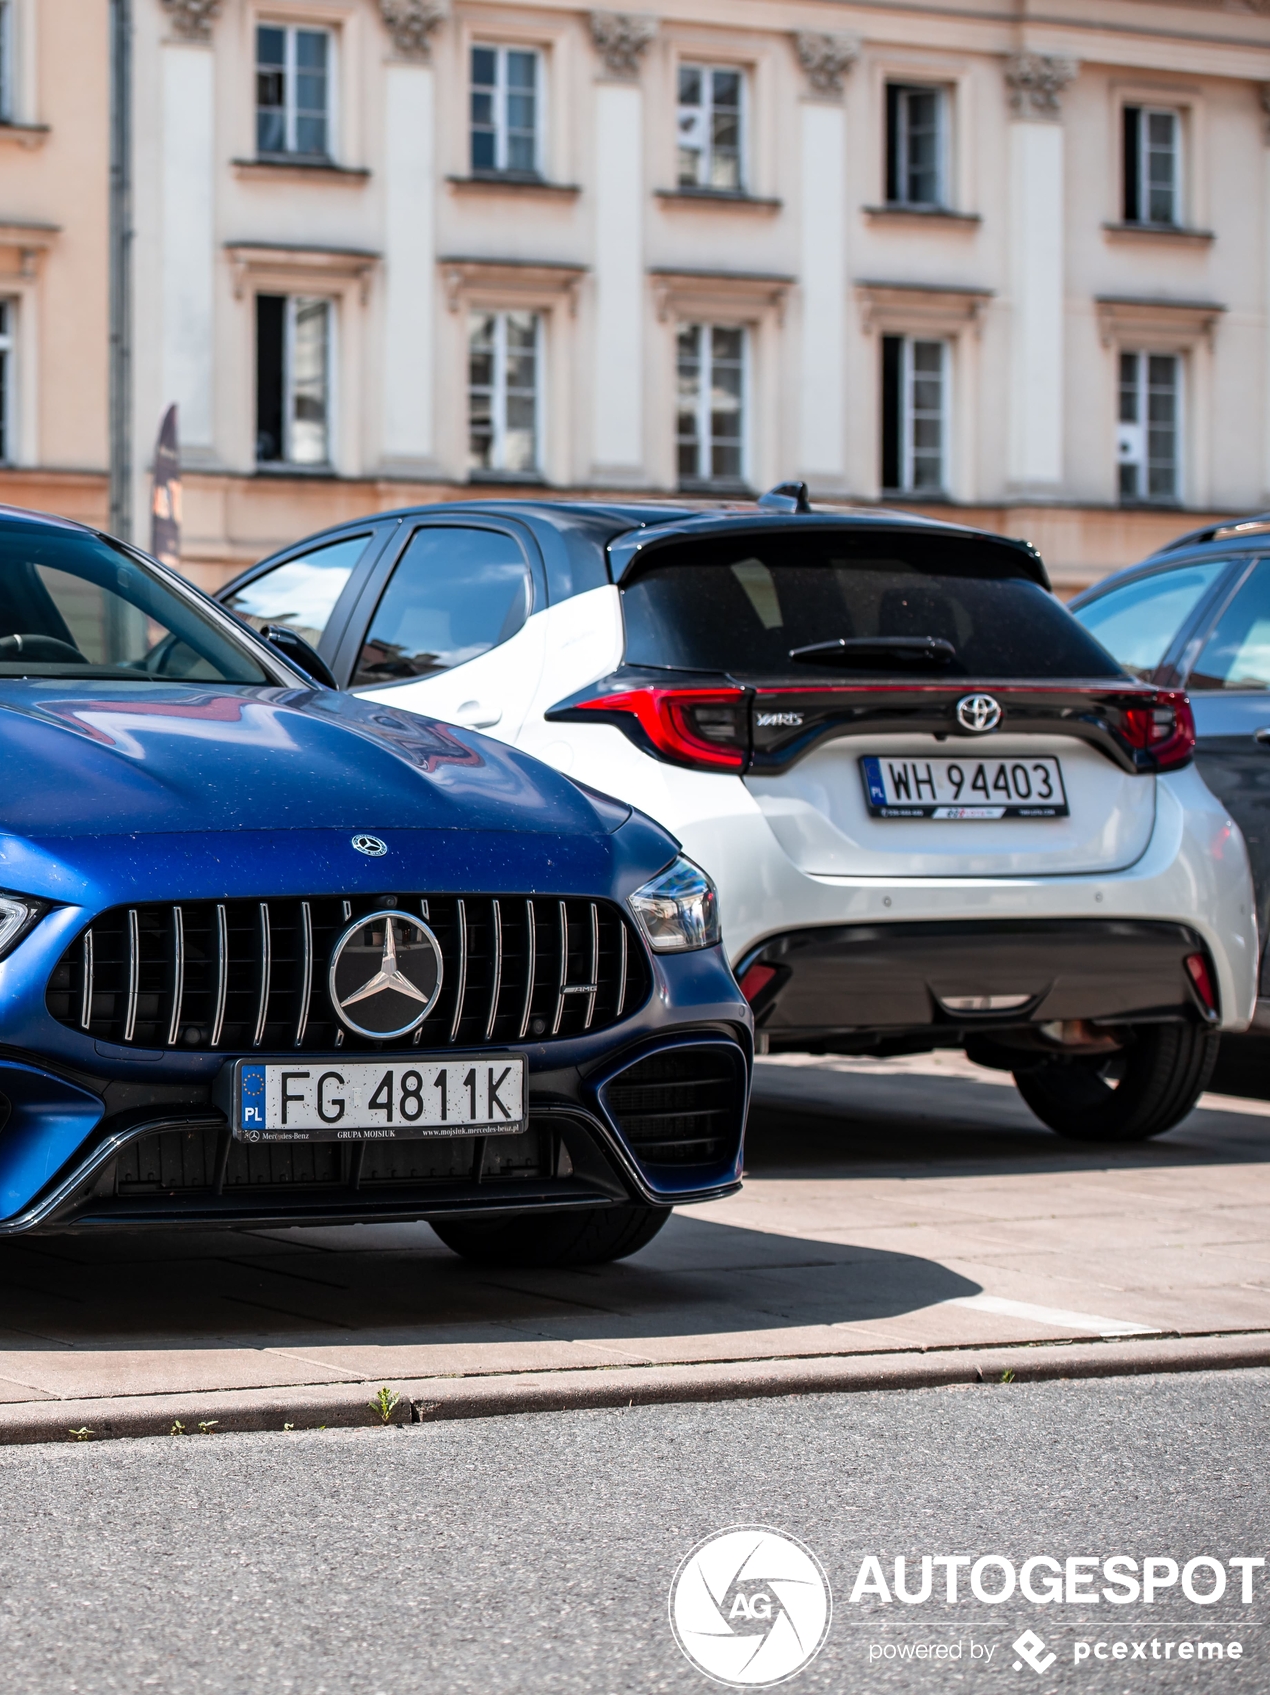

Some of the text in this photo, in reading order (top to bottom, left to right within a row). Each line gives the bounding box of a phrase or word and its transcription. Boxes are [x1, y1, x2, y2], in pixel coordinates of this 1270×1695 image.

[757, 712, 804, 726] YARIS
[888, 763, 1053, 800] WH 94403
[872, 787, 884, 798] PL
[281, 1067, 512, 1124] FG 4811K
[245, 1107, 262, 1122] PL
[337, 1130, 396, 1139] GRUPA MOJSIUK
[422, 1124, 519, 1137] www.mojsiuk.mercedes-benz.pl
